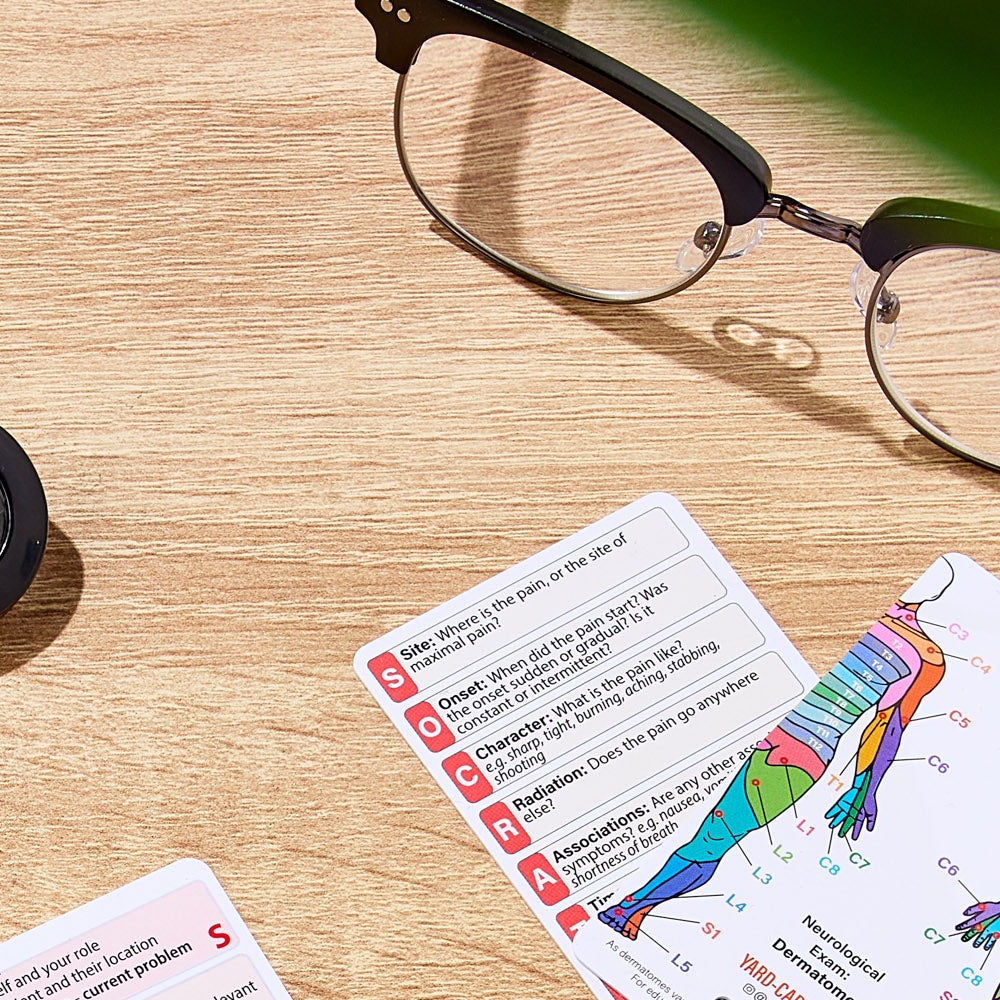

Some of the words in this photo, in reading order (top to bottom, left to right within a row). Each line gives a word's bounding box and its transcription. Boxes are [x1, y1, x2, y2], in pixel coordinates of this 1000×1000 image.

[399, 638, 436, 661] Site:
[433, 615, 480, 642] Where
[478, 608, 493, 619] is
[491, 596, 516, 612] the
[516, 580, 550, 602] pain,
[549, 568, 564, 582] or
[564, 557, 589, 573] the
[588, 544, 613, 561] site
[613, 531, 627, 548] of
[948, 622, 970, 641] C3
[409, 635, 467, 673] maximal
[466, 616, 501, 645] pain?
[970, 656, 992, 675] C4
[381, 667, 405, 689] S
[418, 716, 442, 738] O
[949, 710, 972, 729] C5
[512, 766, 588, 812] Radiation:
[586, 746, 623, 771] Does
[622, 734, 647, 751] the
[646, 717, 677, 741] pain
[677, 707, 696, 724] go
[696, 672, 760, 711] anywhere
[928, 755, 950, 774] C6
[455, 764, 479, 787] C
[827, 774, 844, 792] T1
[523, 798, 556, 823] else?
[492, 818, 519, 842] R
[796, 819, 815, 836] L1
[772, 844, 794, 864] L2
[849, 849, 871, 869] C7
[752, 866, 773, 885] L3
[819, 856, 841, 876] C8
[937, 857, 960, 876] C6
[532, 867, 557, 892] A
[725, 893, 747, 913] L4
[208, 923, 231, 949] S
[701, 922, 721, 940] S1
[924, 927, 946, 945] C7
[801, 914, 886, 983] Neurological
[14, 966, 41, 988] and
[40, 954, 72, 979] your
[73, 942, 101, 960] role
[82, 969, 134, 1000] current
[133, 942, 193, 979] problem
[606, 940, 619, 952] As
[618, 950, 671, 994] dermatomes
[670, 953, 693, 973] L5
[809, 944, 851, 981] Exam:
[961, 967, 983, 987] C8
